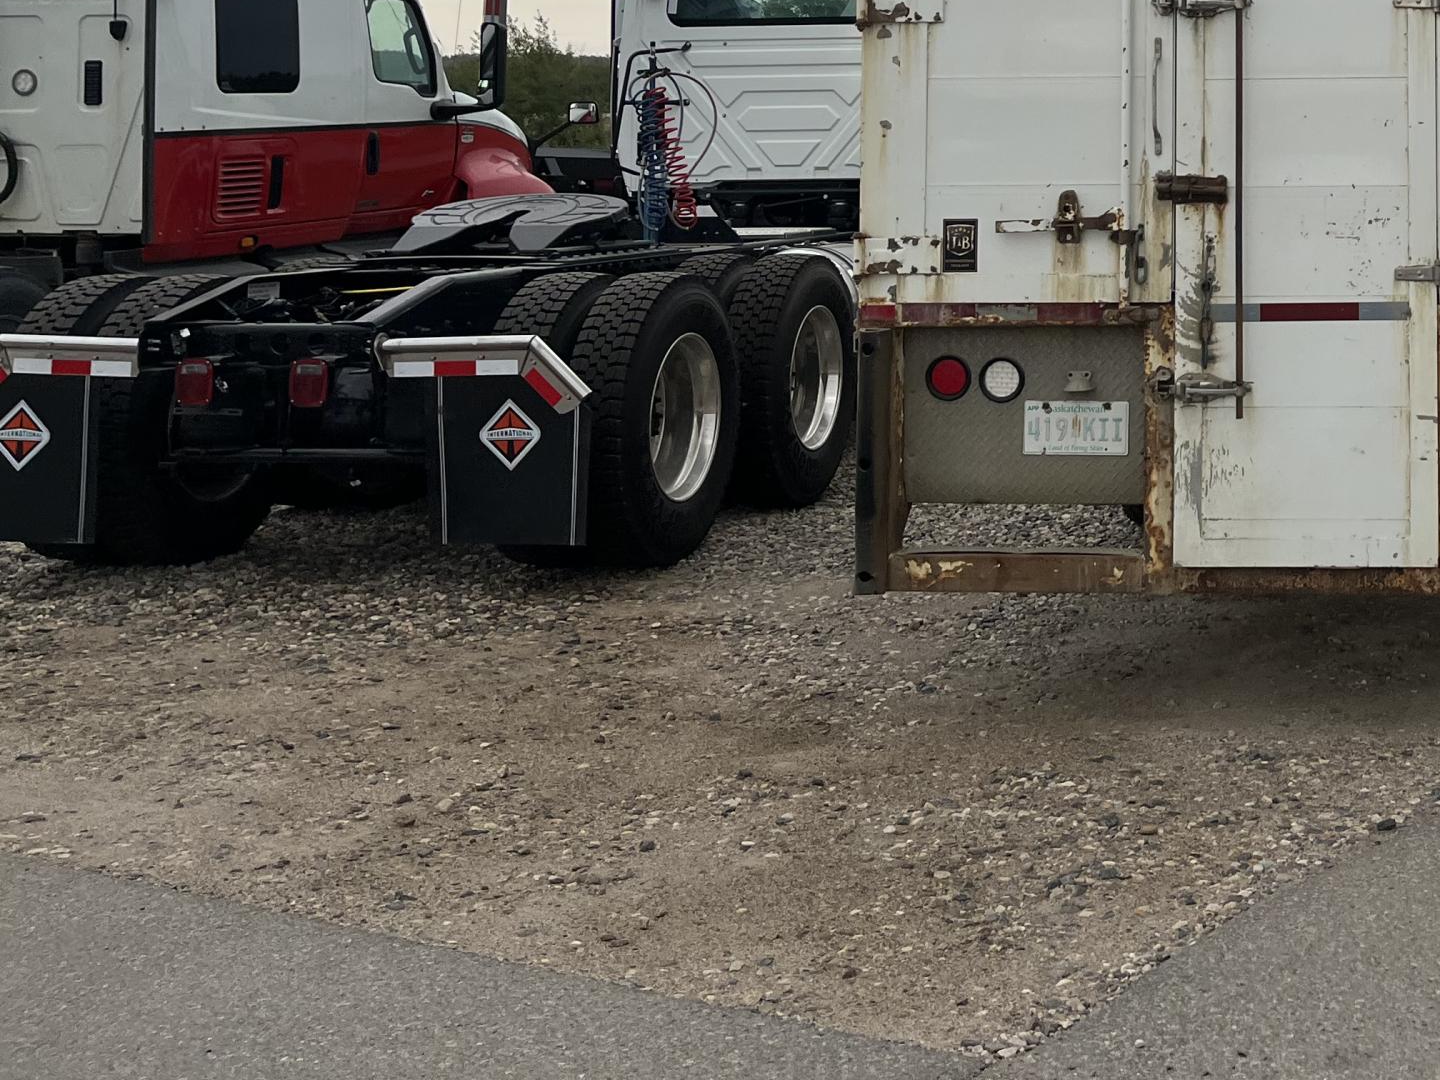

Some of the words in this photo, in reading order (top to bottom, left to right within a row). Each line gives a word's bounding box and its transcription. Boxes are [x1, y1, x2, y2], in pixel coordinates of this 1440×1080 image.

[1044, 404, 1106, 414] askatchewan
[487, 429, 533, 438] INTERNATIONAL
[1027, 417, 1070, 442] 419
